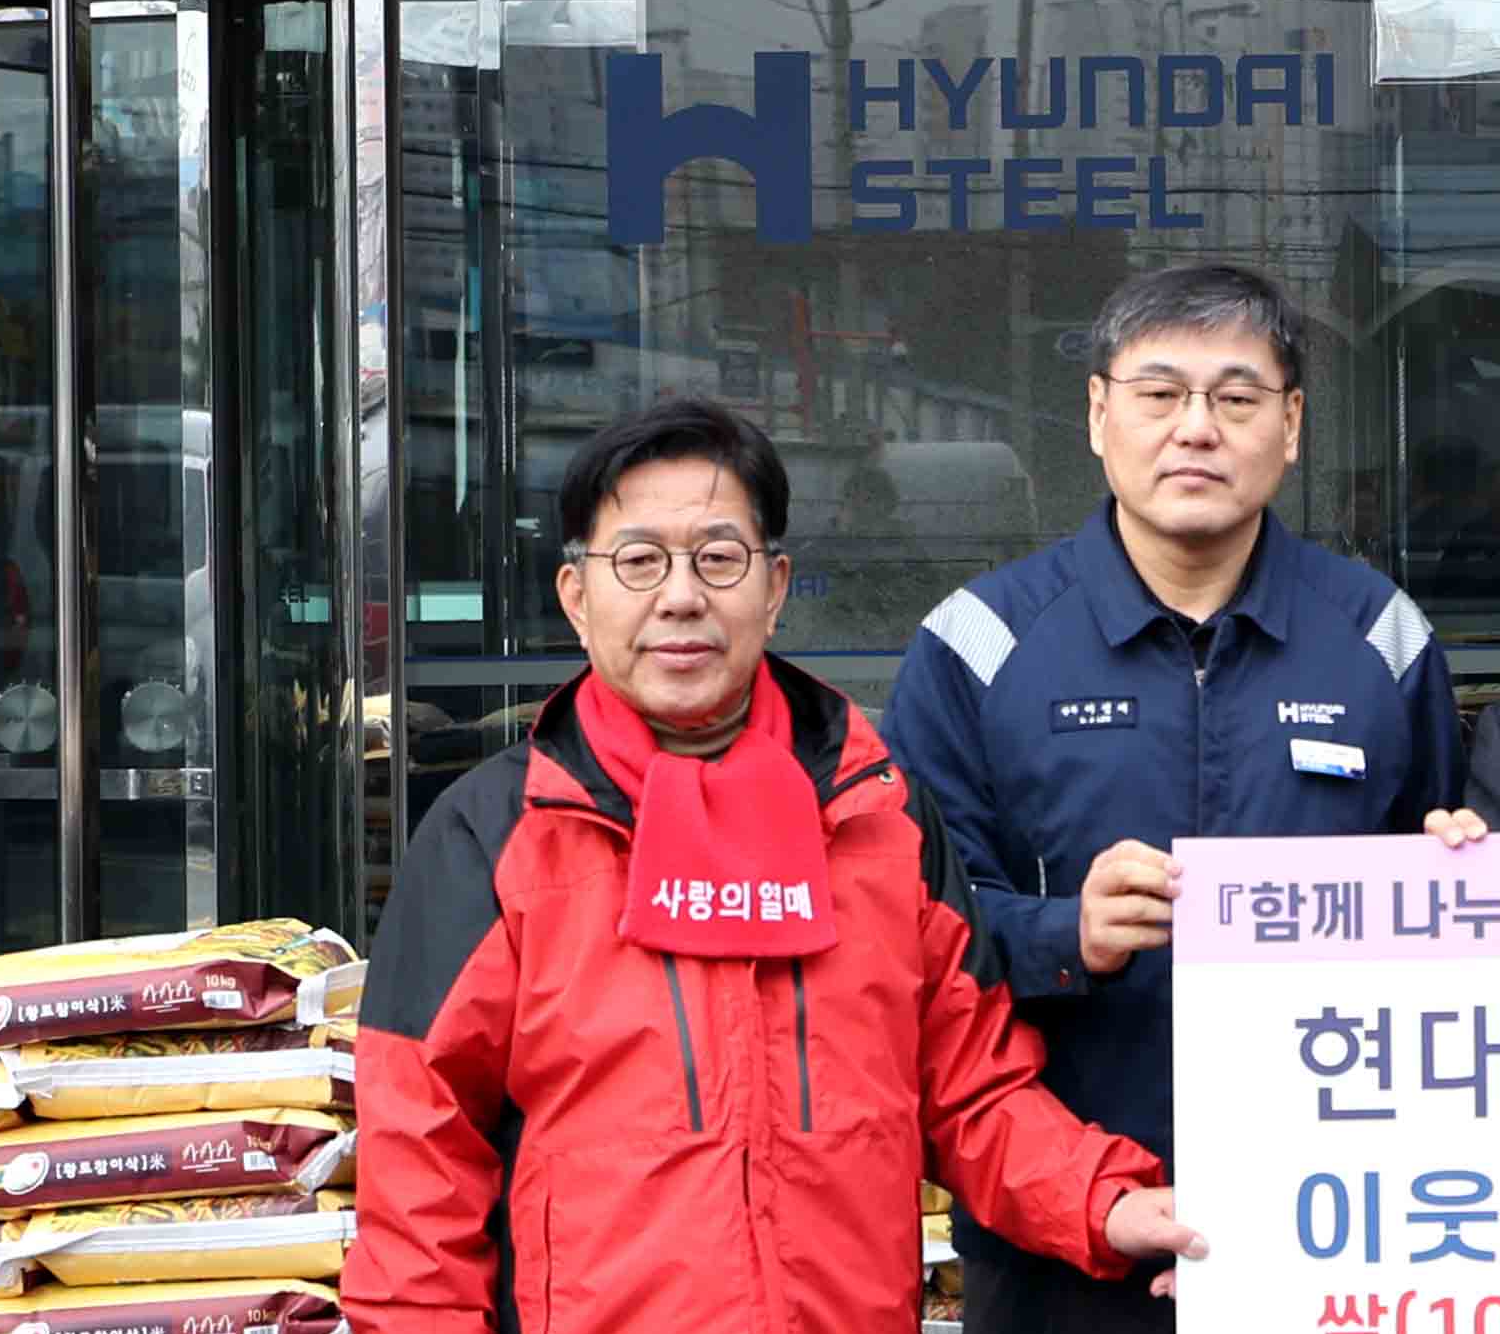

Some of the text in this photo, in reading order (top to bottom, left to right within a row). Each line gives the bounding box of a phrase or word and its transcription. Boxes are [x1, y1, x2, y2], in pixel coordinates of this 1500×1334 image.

[850, 53, 1336, 131] HYUNDAI
[850, 153, 1204, 232] STEEL
[651, 879, 814, 923] 사랑의 열매
